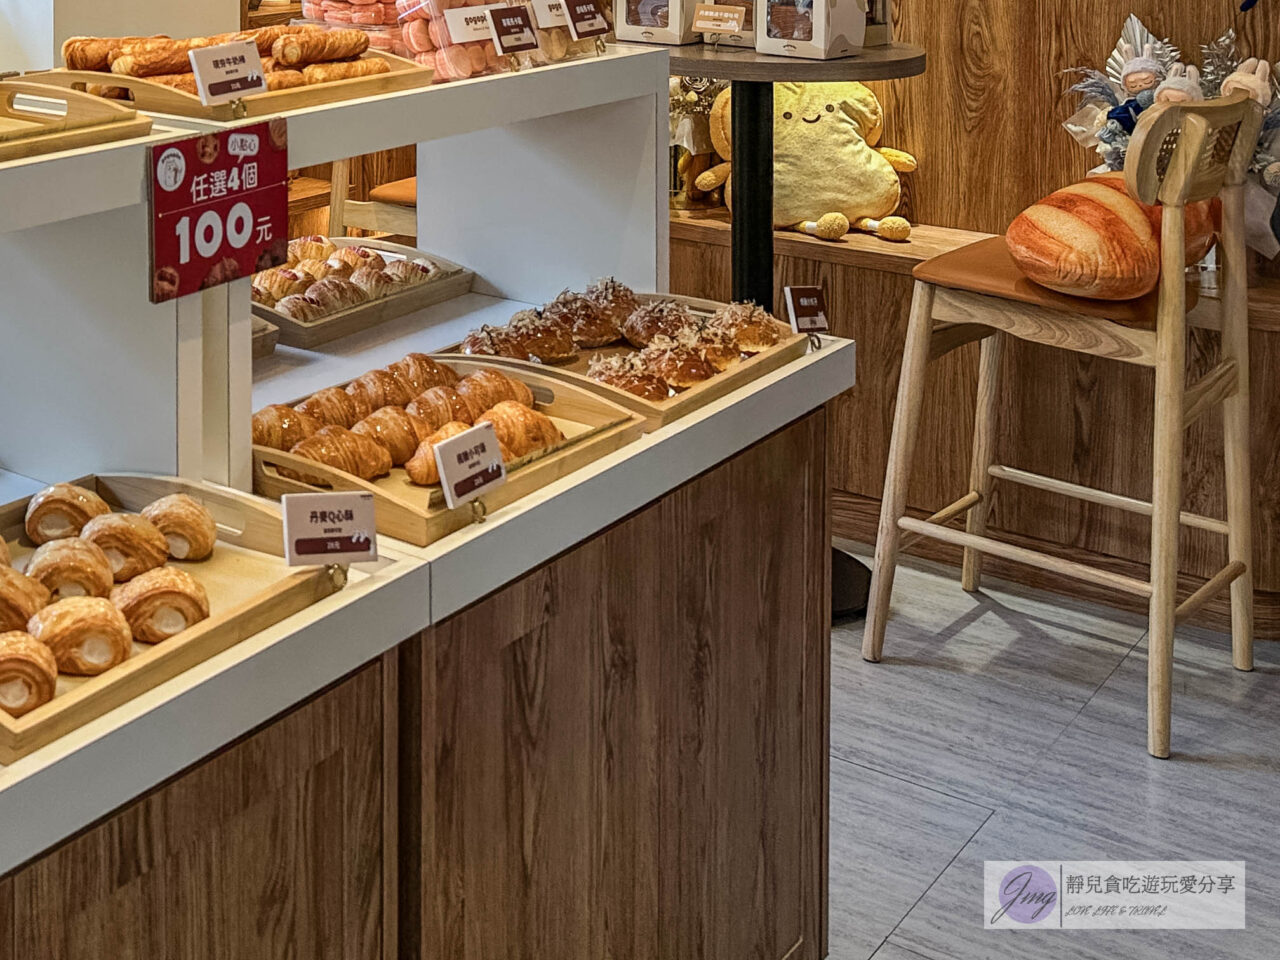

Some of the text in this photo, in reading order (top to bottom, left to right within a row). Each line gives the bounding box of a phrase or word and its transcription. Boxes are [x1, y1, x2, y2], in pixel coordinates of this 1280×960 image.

[229, 137, 257, 152] 小點心
[190, 161, 259, 204] 任選4個
[175, 201, 273, 265] 100元
